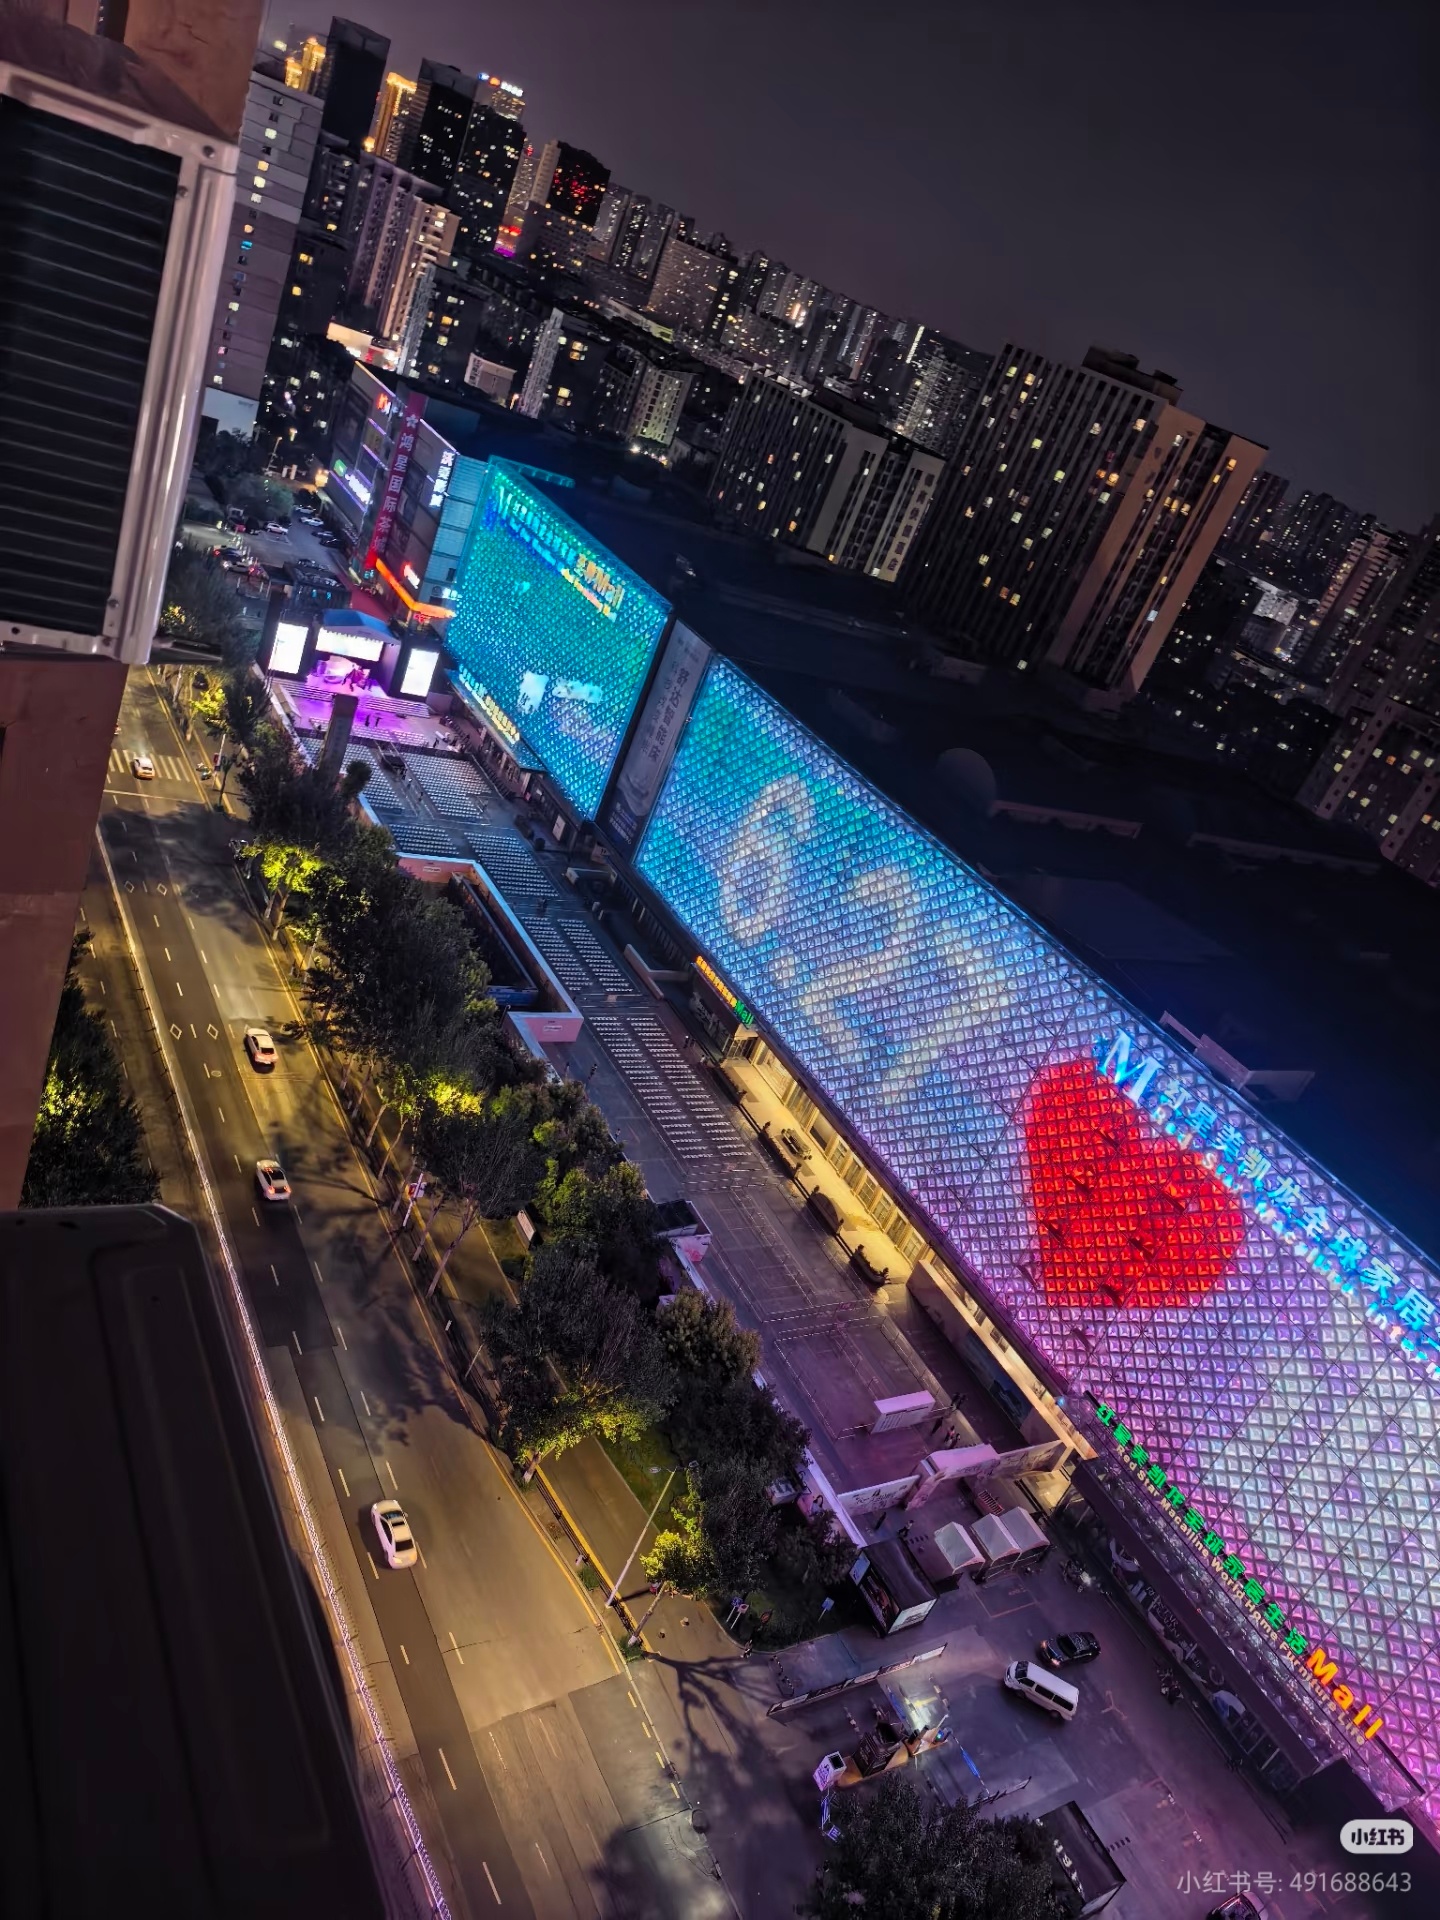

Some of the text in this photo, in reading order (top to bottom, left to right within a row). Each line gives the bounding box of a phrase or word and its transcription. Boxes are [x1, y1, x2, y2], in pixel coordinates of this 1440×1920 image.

[1160, 1079, 1440, 1351] 红星美凯龙全球家居
[1116, 1446, 1365, 1745] Red Star Macalline World Home Furniture Life
